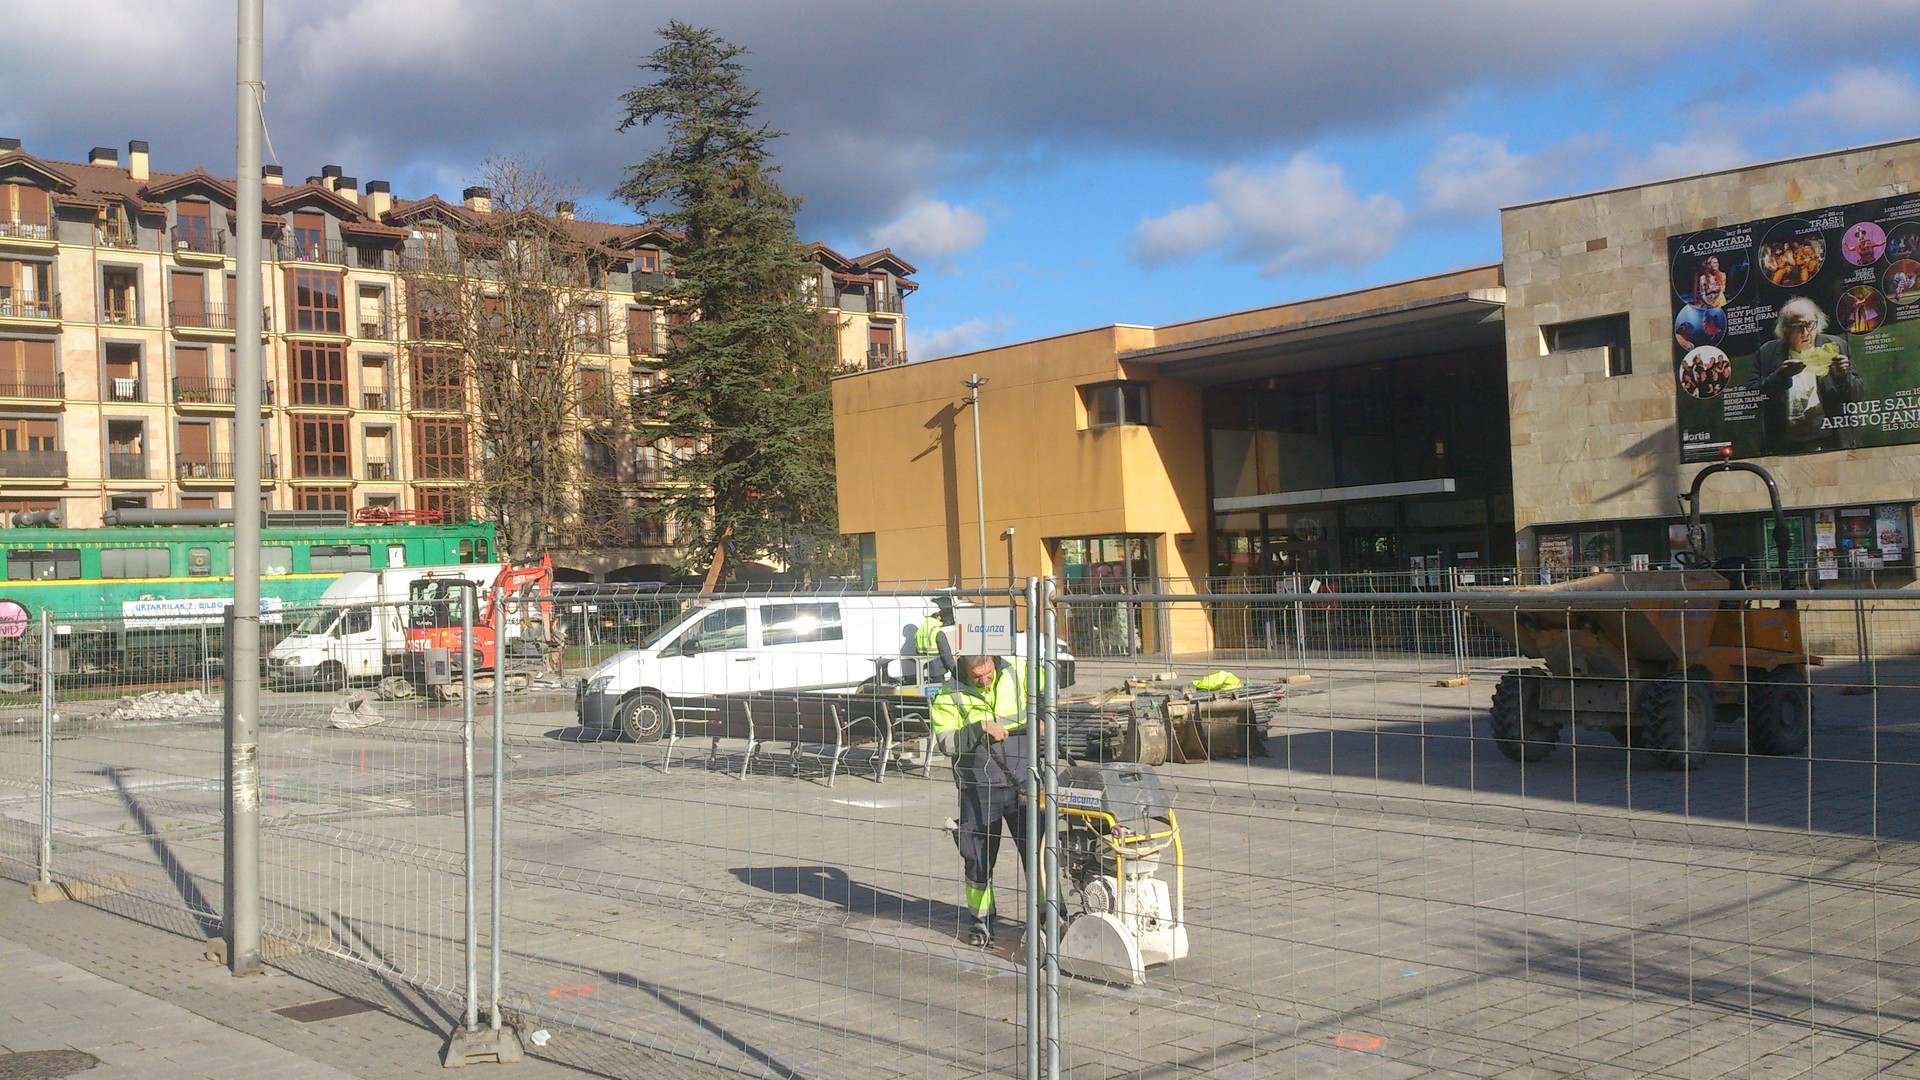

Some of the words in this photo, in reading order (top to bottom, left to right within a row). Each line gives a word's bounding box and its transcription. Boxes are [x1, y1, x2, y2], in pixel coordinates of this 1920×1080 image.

[1682, 244, 1696, 254] LA
[1696, 234, 1752, 251] COARTADA
[1727, 310, 1744, 319] HOY
[1746, 304, 1772, 316] PUEDE
[1755, 311, 1778, 321] GRAN
[1728, 323, 1756, 331] NOCHE
[1884, 396, 1920, 411] SAL
[1881, 422, 1898, 431] ELS
[1900, 421, 1920, 430] JOG
